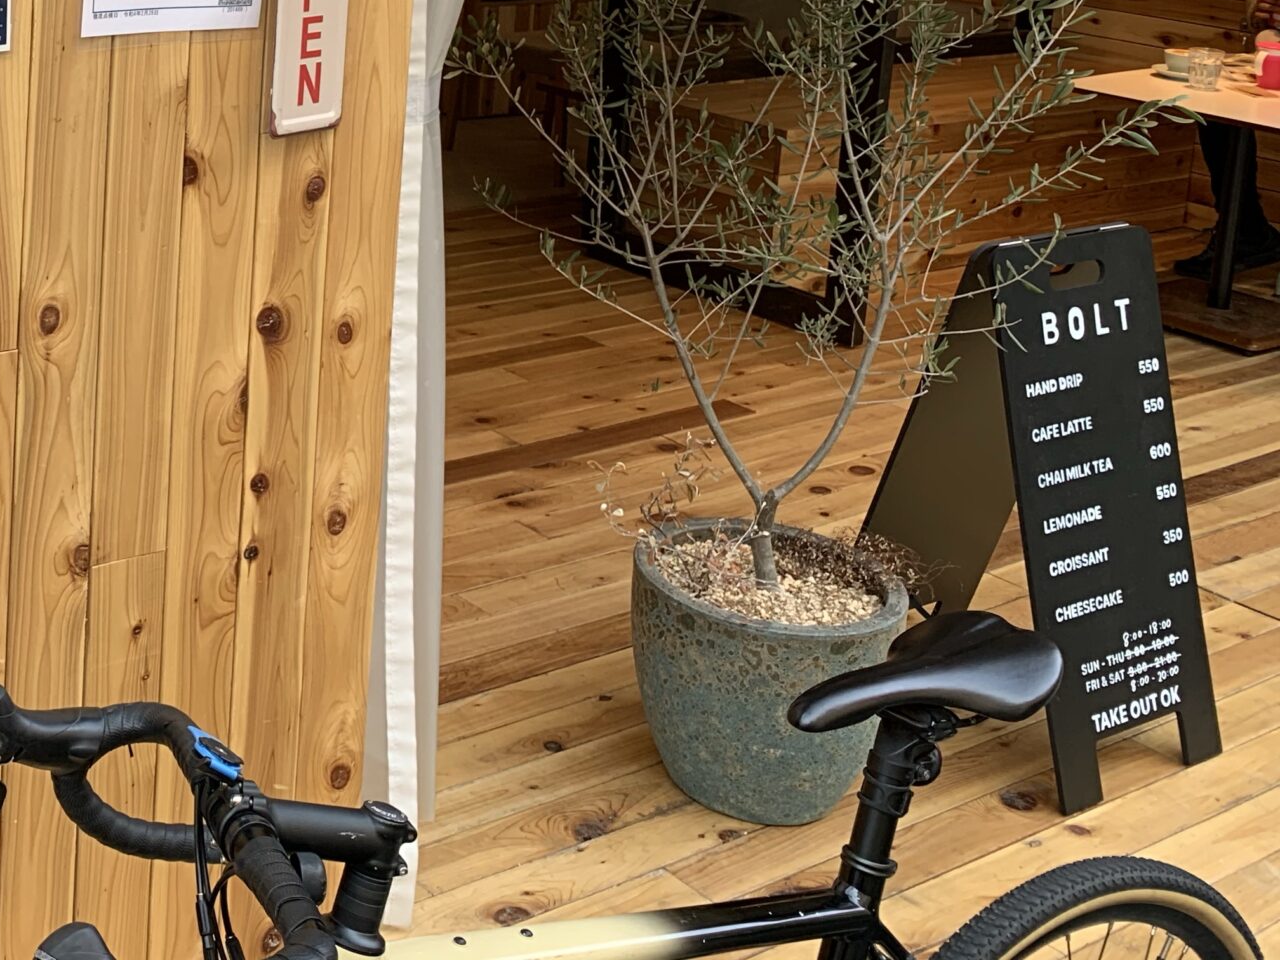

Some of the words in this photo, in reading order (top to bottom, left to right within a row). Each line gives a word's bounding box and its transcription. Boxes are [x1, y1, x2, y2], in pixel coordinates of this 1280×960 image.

[1041, 297, 1130, 345] BOLT
[1025, 378, 1058, 398] HAND
[1058, 373, 1083, 390] DRIP
[1138, 357, 1160, 374] 550
[1032, 423, 1060, 443] CAFE
[1060, 416, 1093, 437] LATTE
[1143, 396, 1164, 414] 550
[1037, 469, 1065, 488] CHAI
[1065, 462, 1092, 482] MILK
[1092, 457, 1114, 474] TEA
[1149, 442, 1171, 460] 600
[1043, 505, 1102, 534] LEMONADE
[1155, 483, 1177, 500] 550
[1049, 547, 1109, 577] CROISSANT
[1162, 527, 1183, 544] 350
[1055, 589, 1123, 623] CHEESECAKE
[1168, 569, 1189, 587] 500
[1081, 659, 1100, 676] SUN
[1106, 651, 1125, 667] THU
[1085, 678, 1100, 693] FRI
[1101, 675, 1108, 687] &
[1108, 669, 1126, 685] SAT
[1091, 704, 1129, 733] TAKE
[1130, 693, 1158, 719] OUT
[1160, 684, 1181, 707] OK
